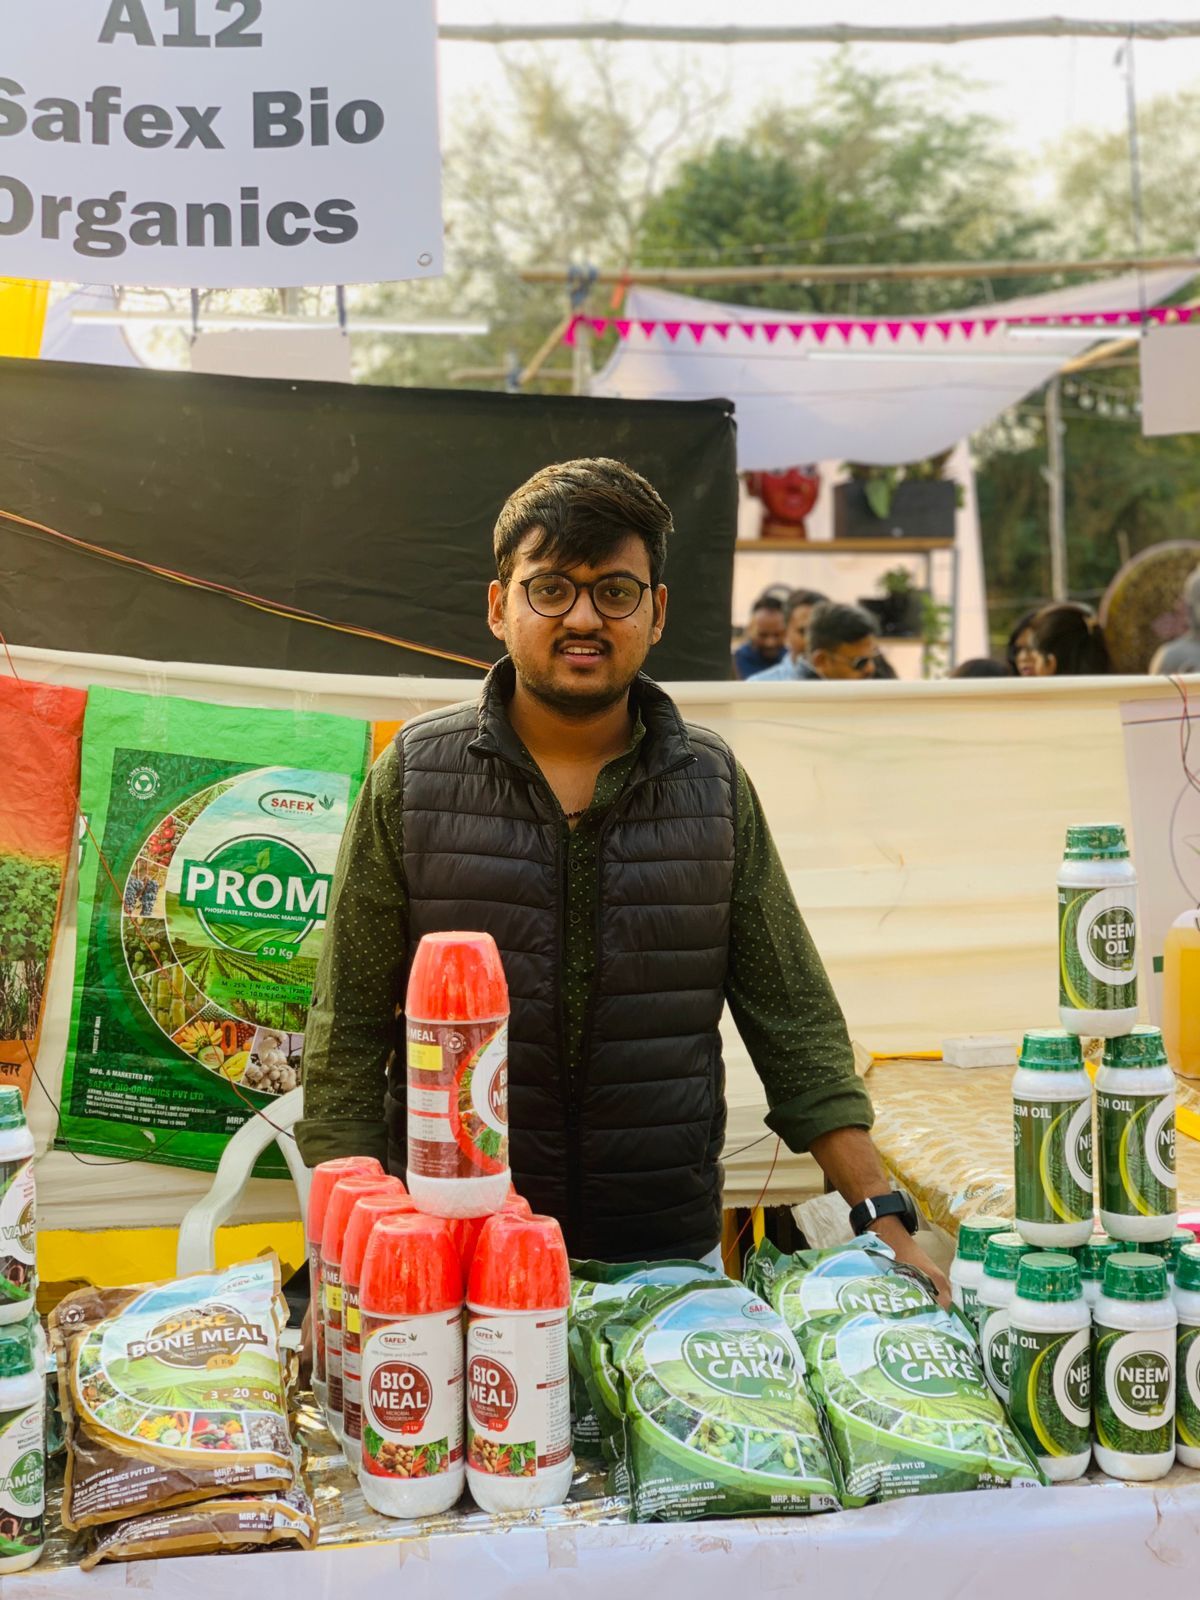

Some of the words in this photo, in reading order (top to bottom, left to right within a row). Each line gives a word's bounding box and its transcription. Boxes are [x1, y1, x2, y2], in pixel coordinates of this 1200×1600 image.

[98, 0, 263, 48] A12
[0, 77, 225, 150] Safex
[252, 87, 385, 149] Bio
[0, 175, 359, 258] Organics
[271, 798, 315, 812] SAFEX
[185, 865, 329, 915] PROM
[204, 907, 239, 916] PHOSPHATE
[239, 910, 253, 918] RICH
[253, 912, 281, 920] ORGANIC
[1093, 922, 1135, 940] NEEM
[262, 946, 277, 956] 50
[279, 948, 294, 960] Kg
[1105, 940, 1129, 955] OIL
[409, 1029, 437, 1043] MEAL
[111, 1070, 143, 1080] MARKETED
[171, 1089, 188, 1099] PVT
[189, 1091, 205, 1101] LTD
[1031, 1107, 1052, 1118] OIL
[1112, 1100, 1133, 1112] OIL
[166, 1315, 227, 1335] PURE
[131, 1333, 195, 1358] BONE
[202, 1326, 264, 1344] MEAL
[384, 1336, 407, 1344] SAFEX
[1021, 1336, 1040, 1349] OIL
[694, 1339, 784, 1367] NEEM
[886, 1340, 977, 1365] NEEM
[473, 1364, 501, 1387] BIO
[707, 1359, 788, 1381] CAKE
[901, 1361, 980, 1383] CAKE
[1119, 1366, 1168, 1384] NEEM
[380, 1371, 416, 1390] BIO
[210, 1390, 218, 1400] 3
[235, 1387, 250, 1398] 20
[469, 1381, 512, 1408] MEAL
[1130, 1385, 1159, 1399] OIL
[372, 1389, 428, 1410] MEAL
[130, 1469, 142, 1479] PVT
[143, 1466, 156, 1475] LTD
[901, 1462, 913, 1470] PVT
[914, 1461, 926, 1469] LTD
[690, 1482, 702, 1490] PVT
[703, 1481, 715, 1489] LTD
[770, 1494, 790, 1503] MRP.
[239, 1512, 259, 1522] MRP.
